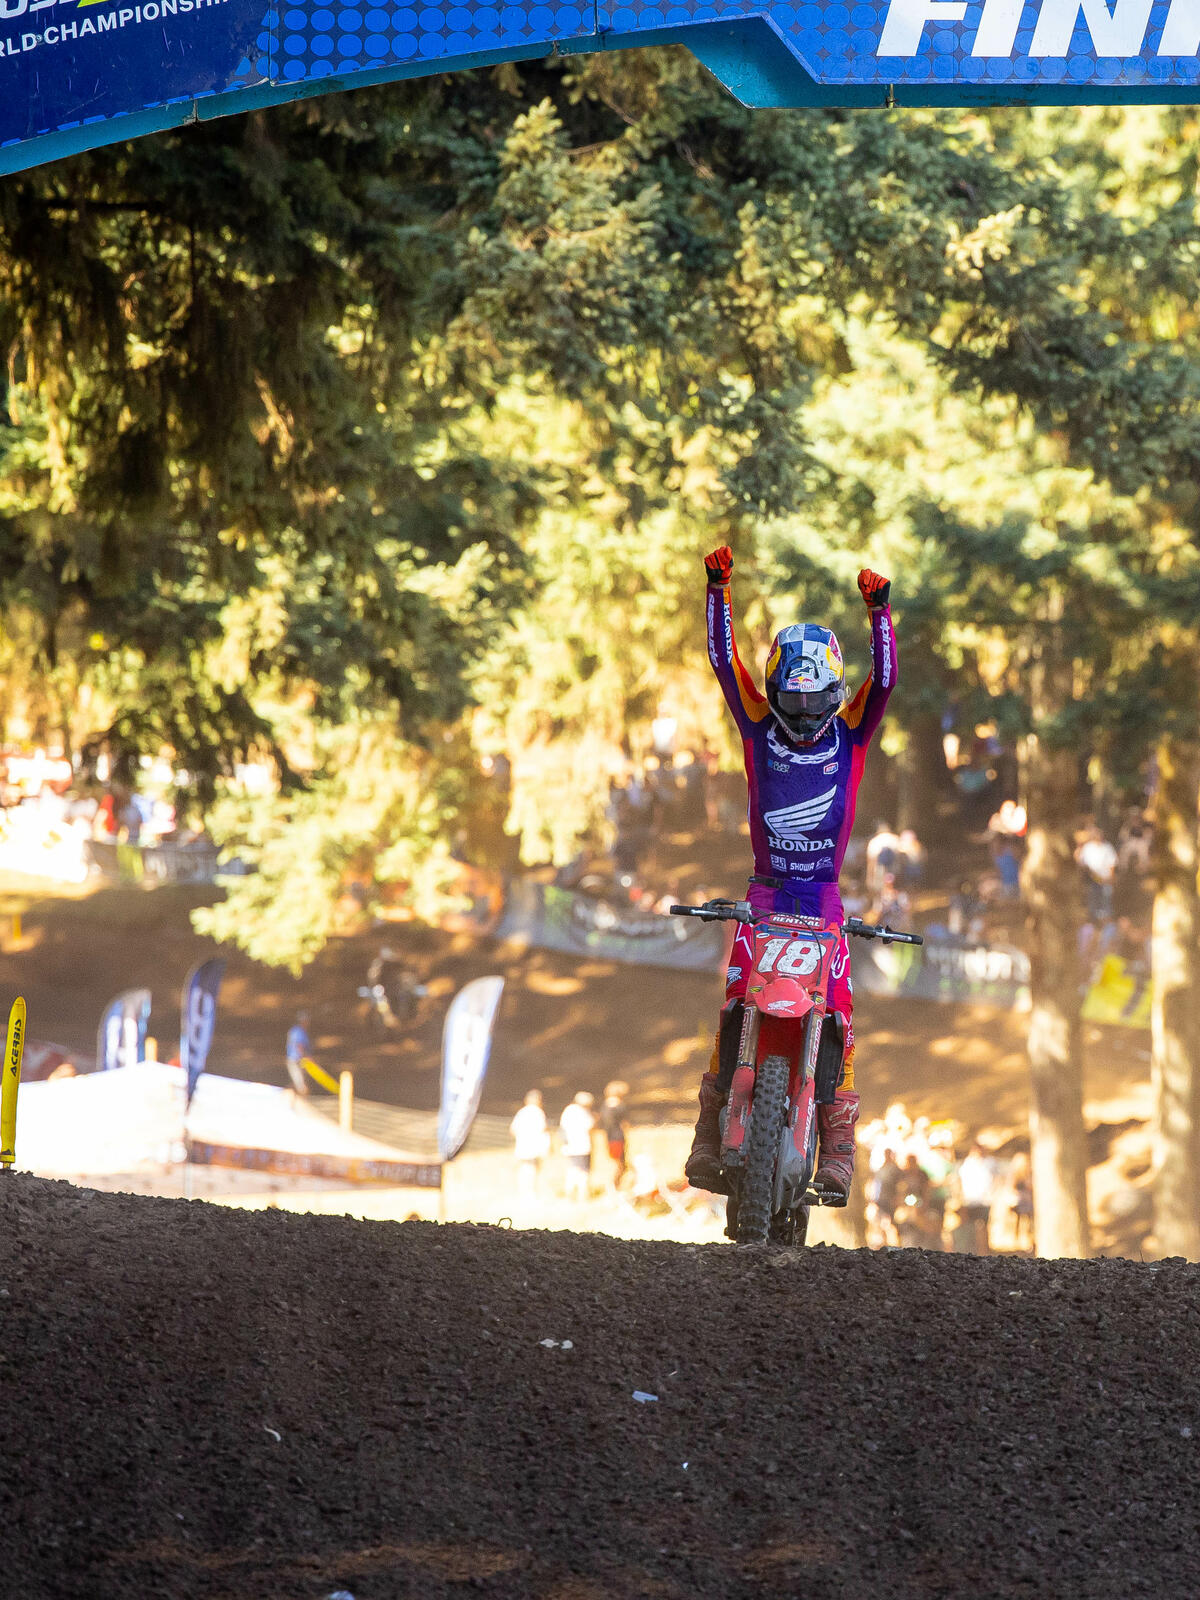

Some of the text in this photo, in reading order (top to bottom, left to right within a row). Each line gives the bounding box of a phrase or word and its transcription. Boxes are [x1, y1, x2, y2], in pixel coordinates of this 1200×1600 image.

[43, 0, 231, 44] CHAMPIONS
[723, 603, 733, 664] HONDA
[880, 615, 892, 688] alpinestars
[767, 836, 835, 852] HONDA
[790, 862, 815, 872] SHOWA
[772, 916, 820, 927] RENTHAL
[757, 938, 827, 975] 18
